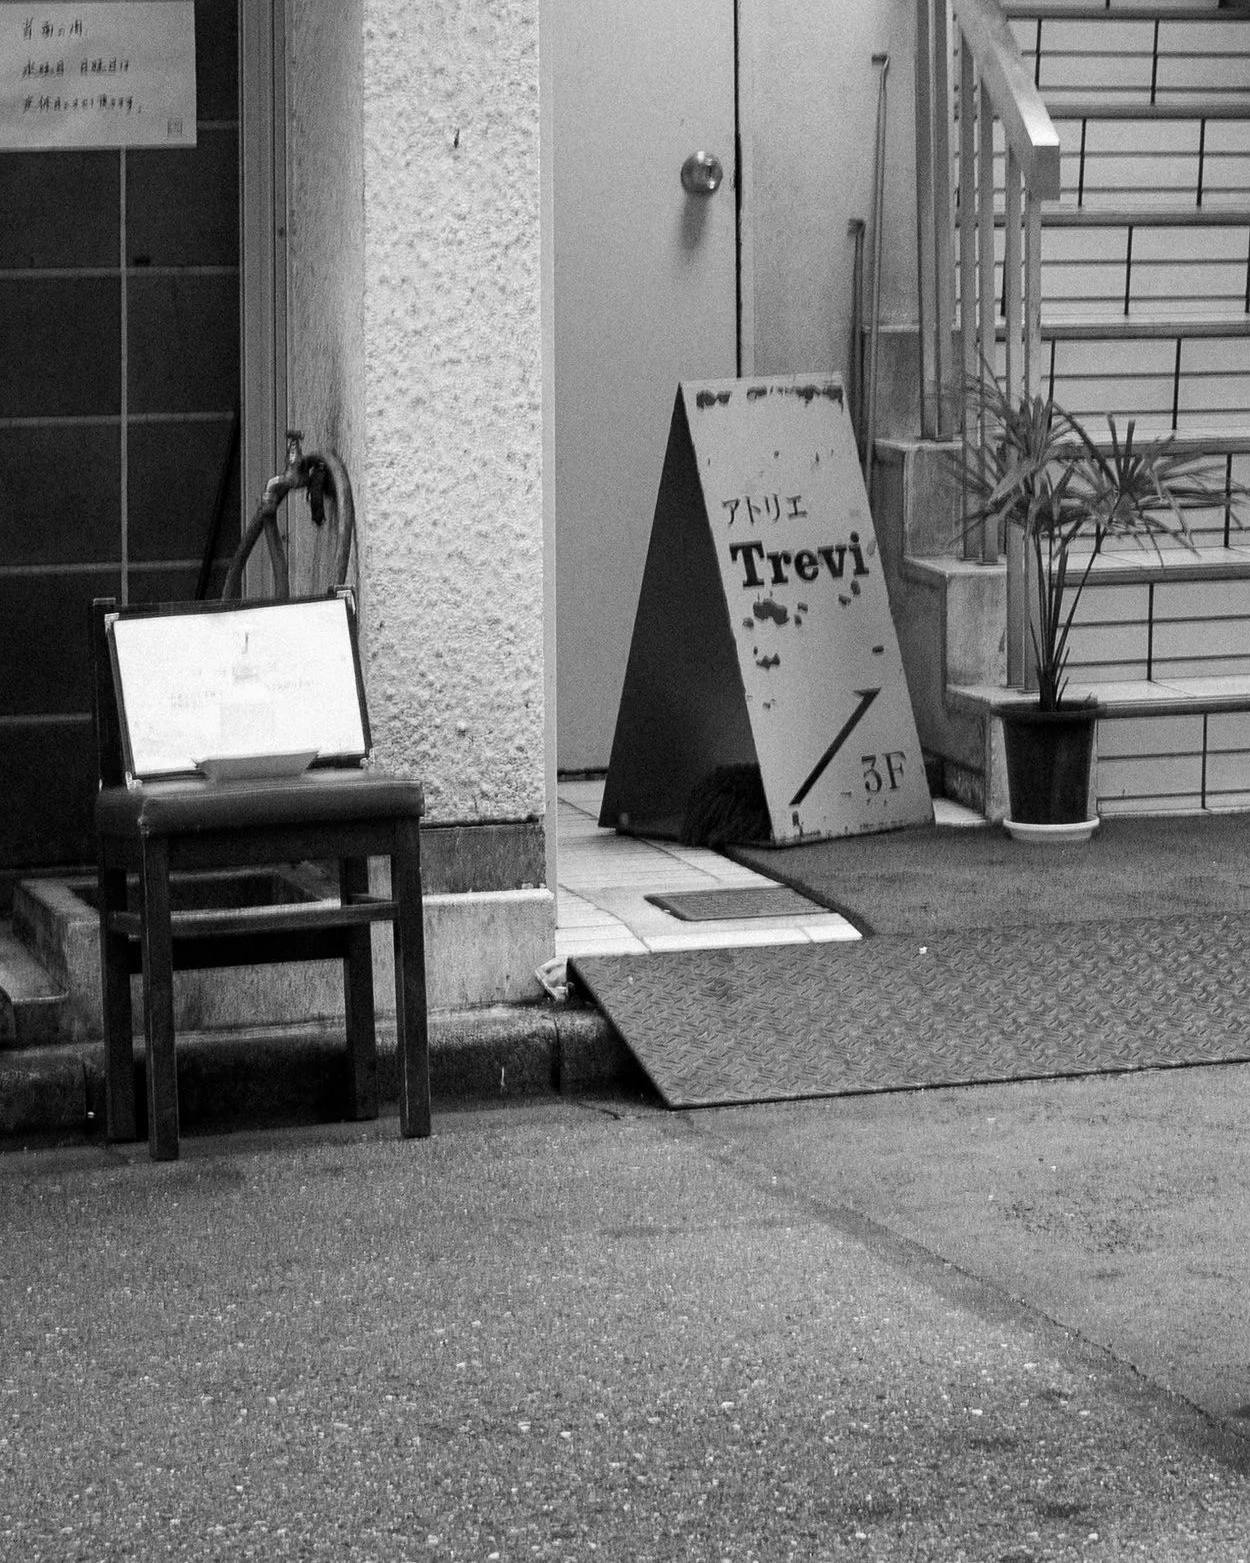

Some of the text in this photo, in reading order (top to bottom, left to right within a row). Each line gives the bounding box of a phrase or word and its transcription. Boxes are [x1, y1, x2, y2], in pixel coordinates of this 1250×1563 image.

[721, 493, 808, 527] アトリエ
[729, 531, 870, 589] Trevi
[861, 751, 907, 794] 3F
